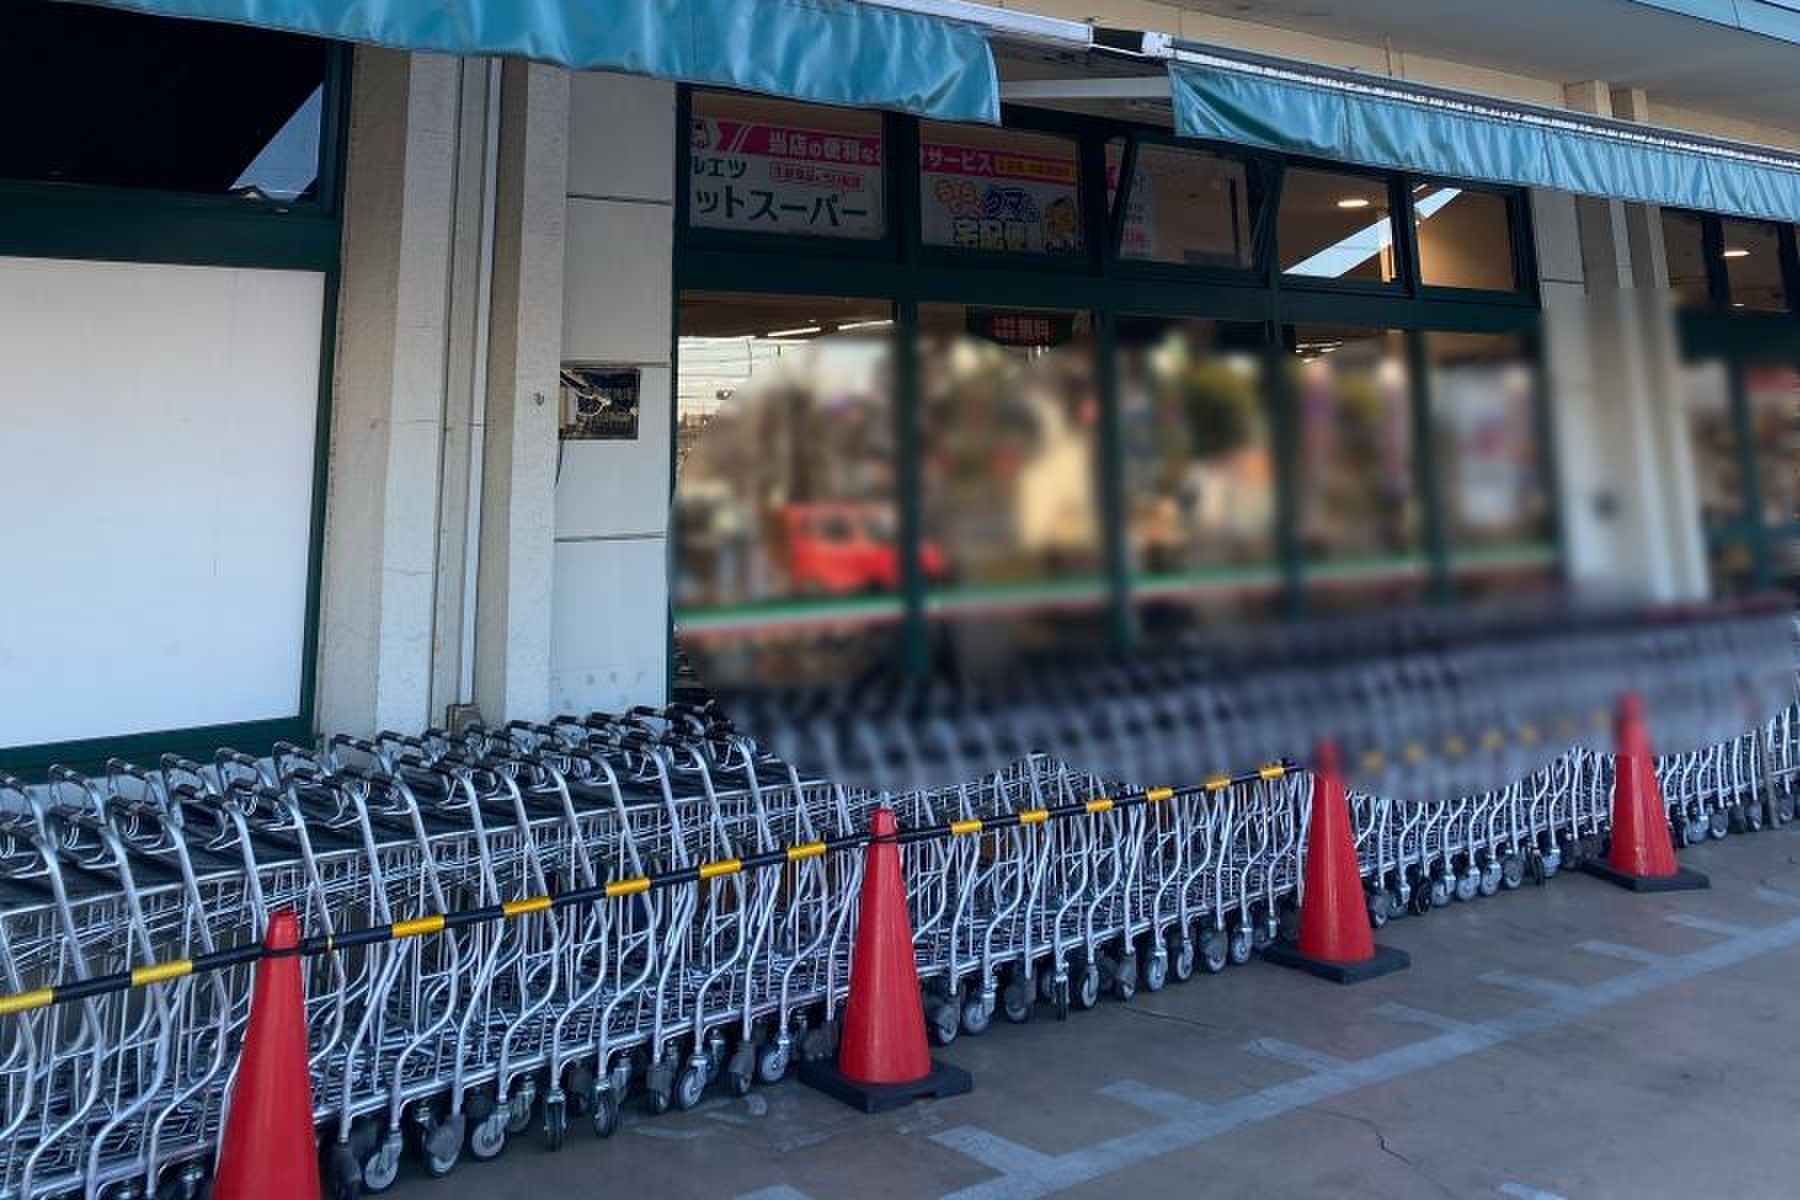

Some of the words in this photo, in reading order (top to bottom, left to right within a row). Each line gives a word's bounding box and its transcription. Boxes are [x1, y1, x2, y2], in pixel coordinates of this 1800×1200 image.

[696, 184, 867, 227] ットスーパー
